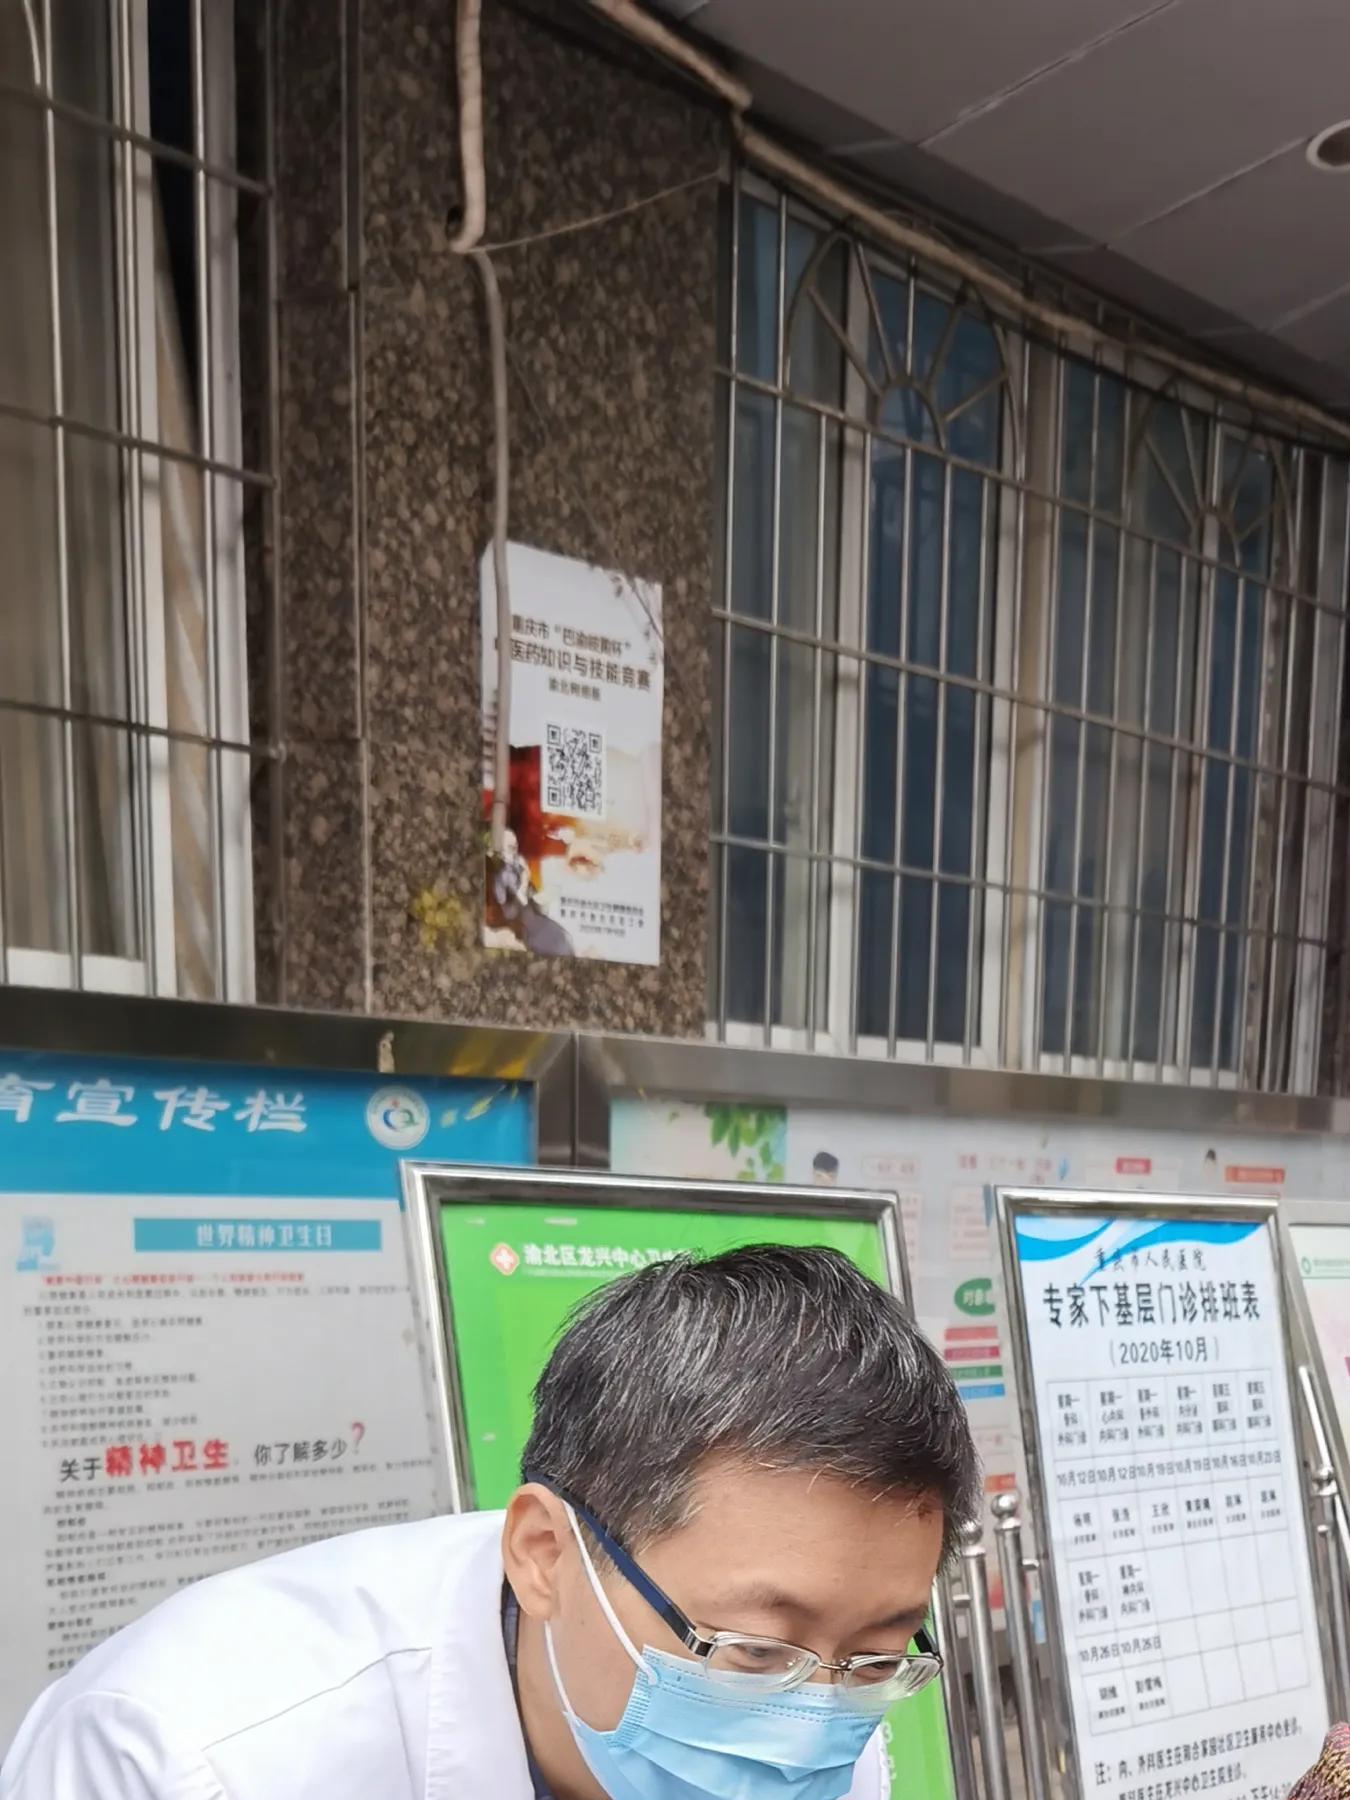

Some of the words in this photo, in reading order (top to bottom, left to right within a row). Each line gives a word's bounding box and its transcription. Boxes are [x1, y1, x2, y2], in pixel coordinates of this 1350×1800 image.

[494, 638, 650, 692] 医药知识与技能竞赛
[195, 1223, 333, 1248] 世界精神卫生日
[1043, 1280, 1260, 1329] 专家下基层门诊排班表
